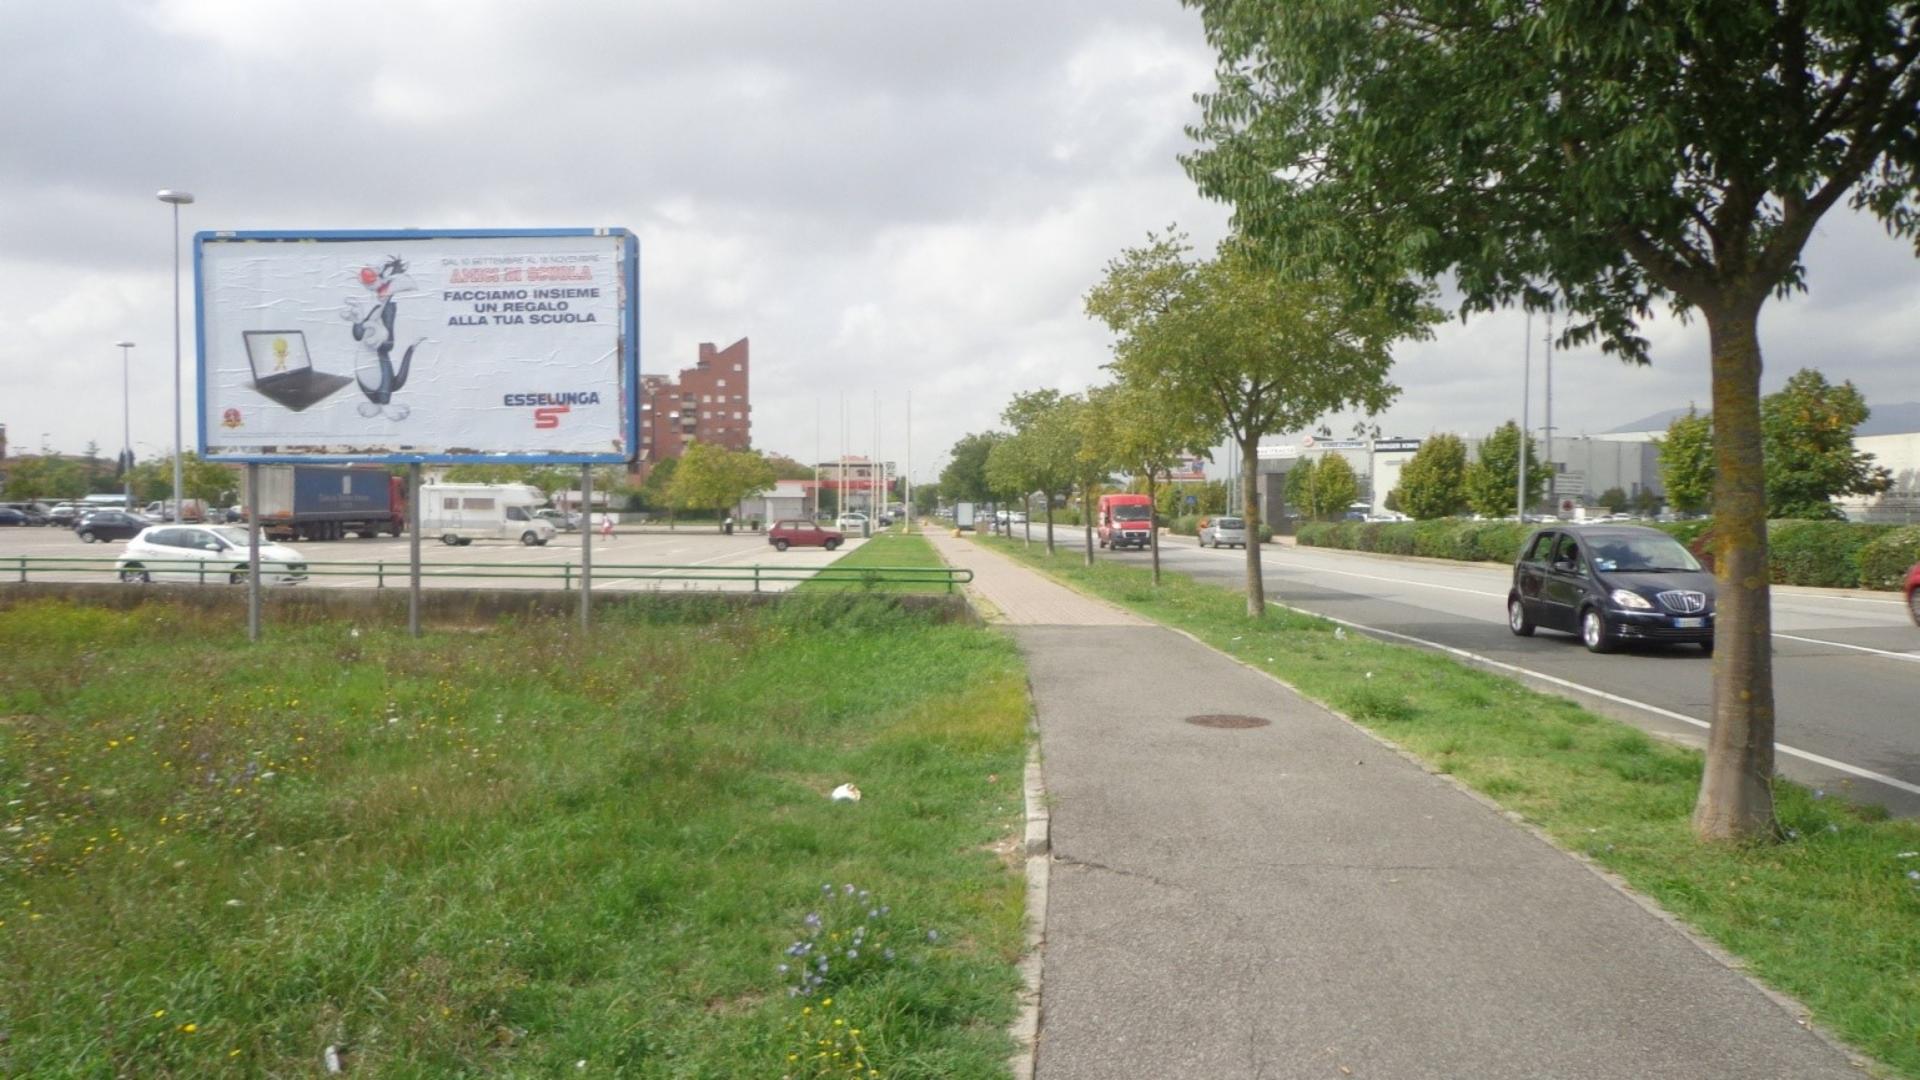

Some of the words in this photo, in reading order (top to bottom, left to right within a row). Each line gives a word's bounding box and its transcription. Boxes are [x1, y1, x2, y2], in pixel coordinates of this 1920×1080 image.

[527, 265, 593, 281] SCUOLA
[443, 289, 528, 301] FACCIAMO
[533, 288, 600, 299] INSIEME
[474, 302, 497, 313] UN
[503, 301, 569, 312] REGALO
[448, 315, 488, 326] ALLA
[494, 314, 524, 325] TUA
[529, 313, 596, 324] SCUOLA
[504, 391, 600, 406] ESSELUNGA
